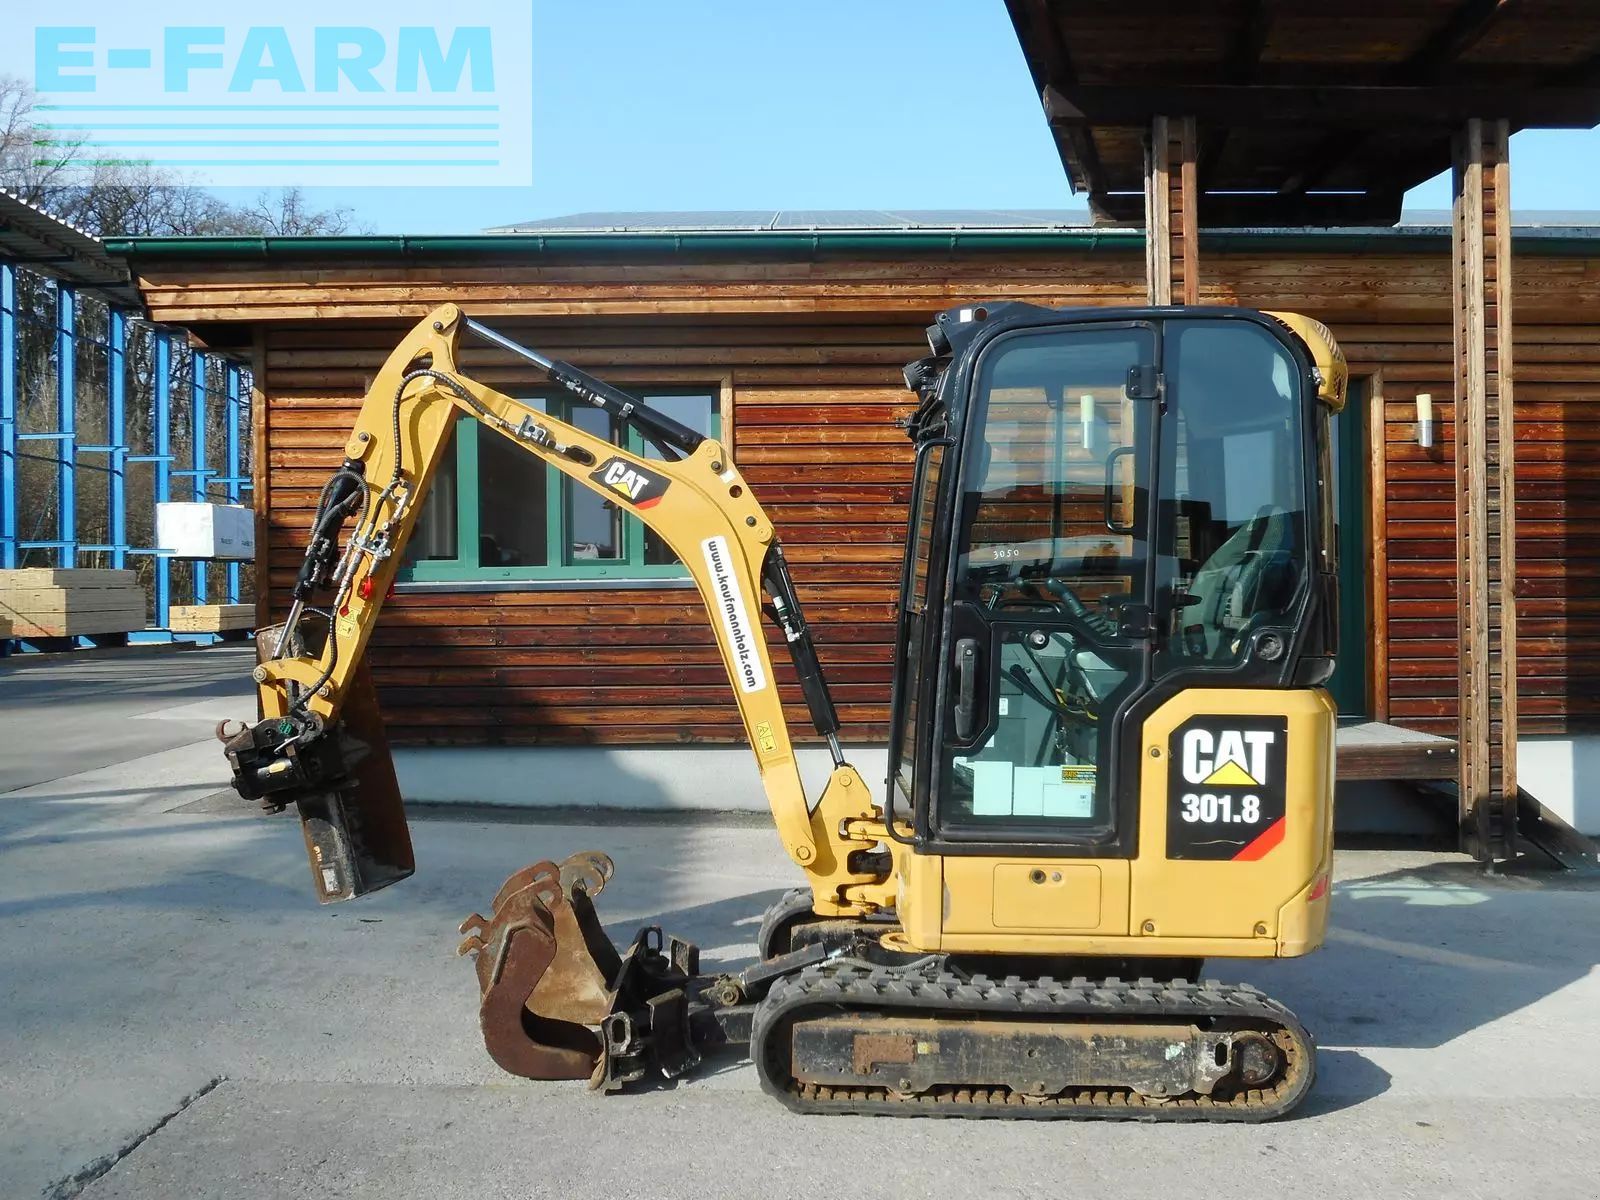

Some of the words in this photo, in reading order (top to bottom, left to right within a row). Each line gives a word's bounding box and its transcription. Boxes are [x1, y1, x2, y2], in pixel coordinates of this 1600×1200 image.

[604, 461, 650, 500] CAT
[993, 549, 1020, 560] 3050
[708, 541, 756, 687] www.kaufmannholz.com
[1182, 728, 1275, 786] CAT
[1181, 793, 1260, 824] 301.8
